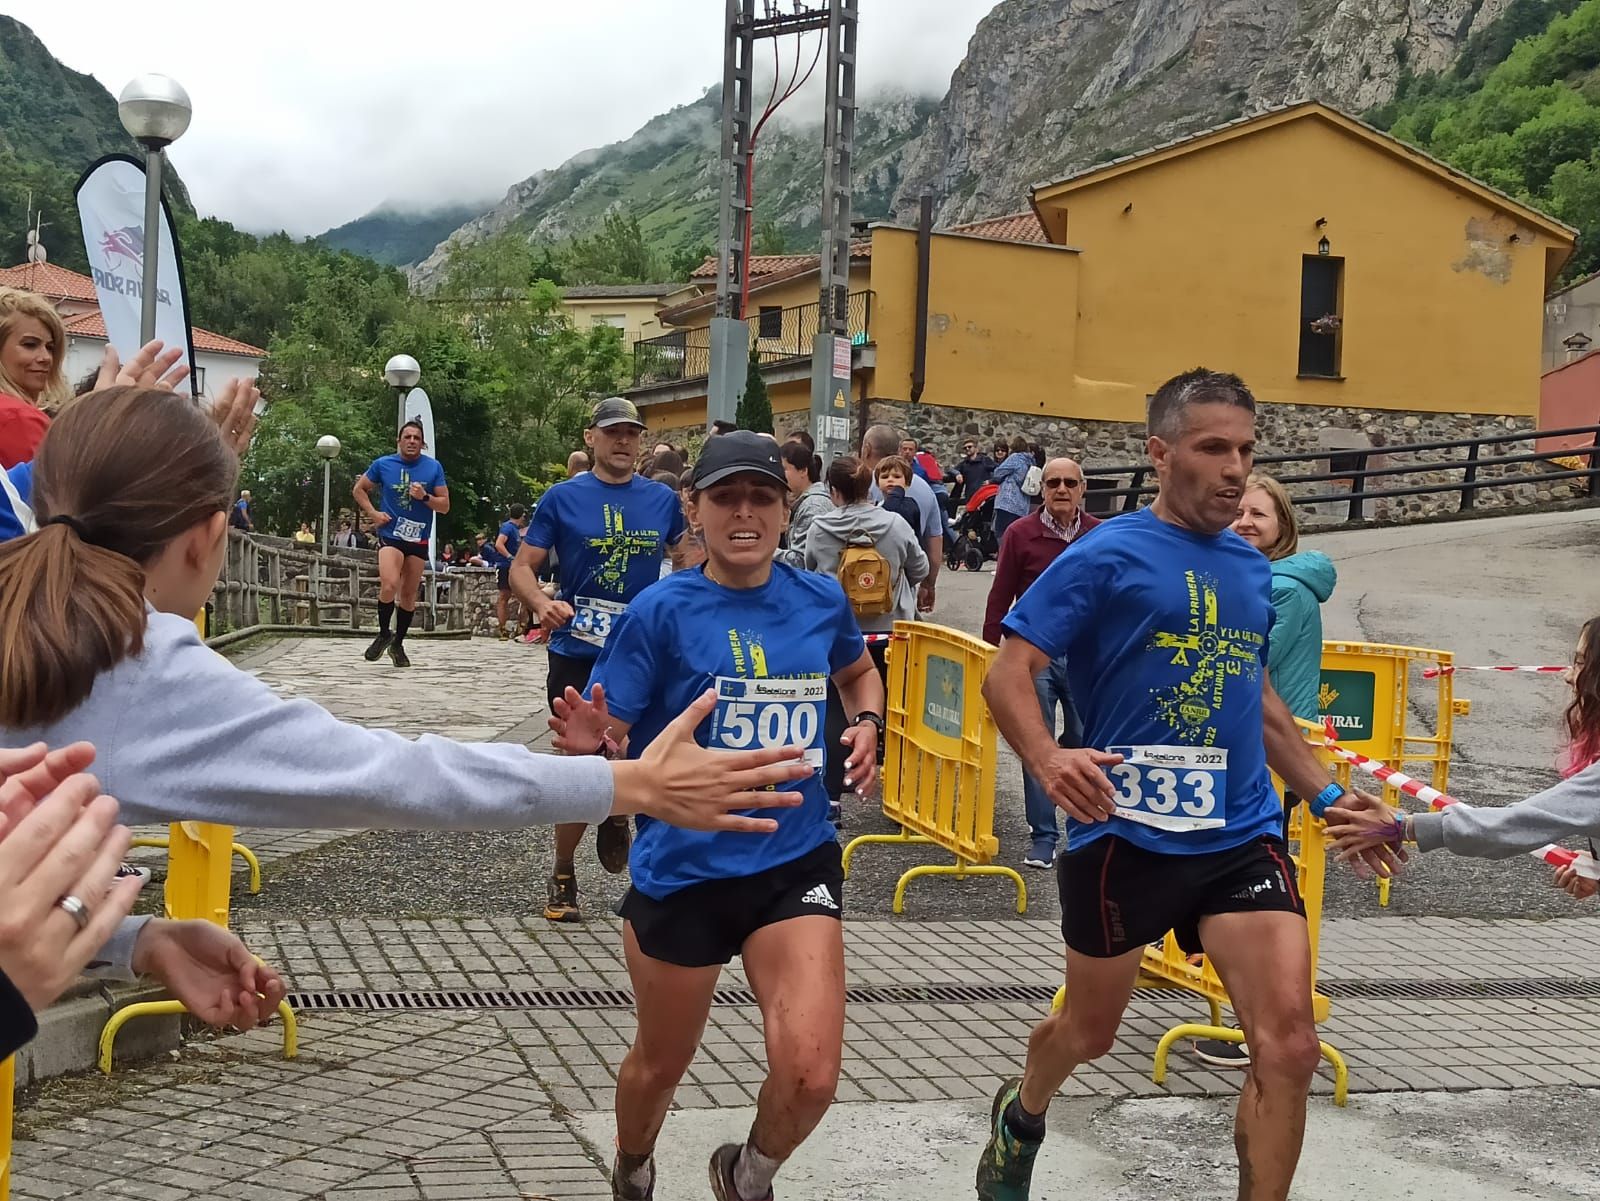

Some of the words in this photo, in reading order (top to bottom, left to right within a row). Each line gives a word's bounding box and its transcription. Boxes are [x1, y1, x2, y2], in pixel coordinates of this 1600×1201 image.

[1184, 570, 1200, 615] PRIMERA
[1188, 618, 1200, 632] LA
[1220, 627, 1227, 637] Y
[1228, 628, 1240, 639] LA
[727, 628, 746, 673] PRIMERA
[804, 687, 825, 696] 2022
[1212, 662, 1225, 710] ASTURIAS
[720, 702, 818, 749] 500
[1202, 726, 1217, 747] 022
[1195, 754, 1222, 764] 2022
[1110, 763, 1216, 817] 333
